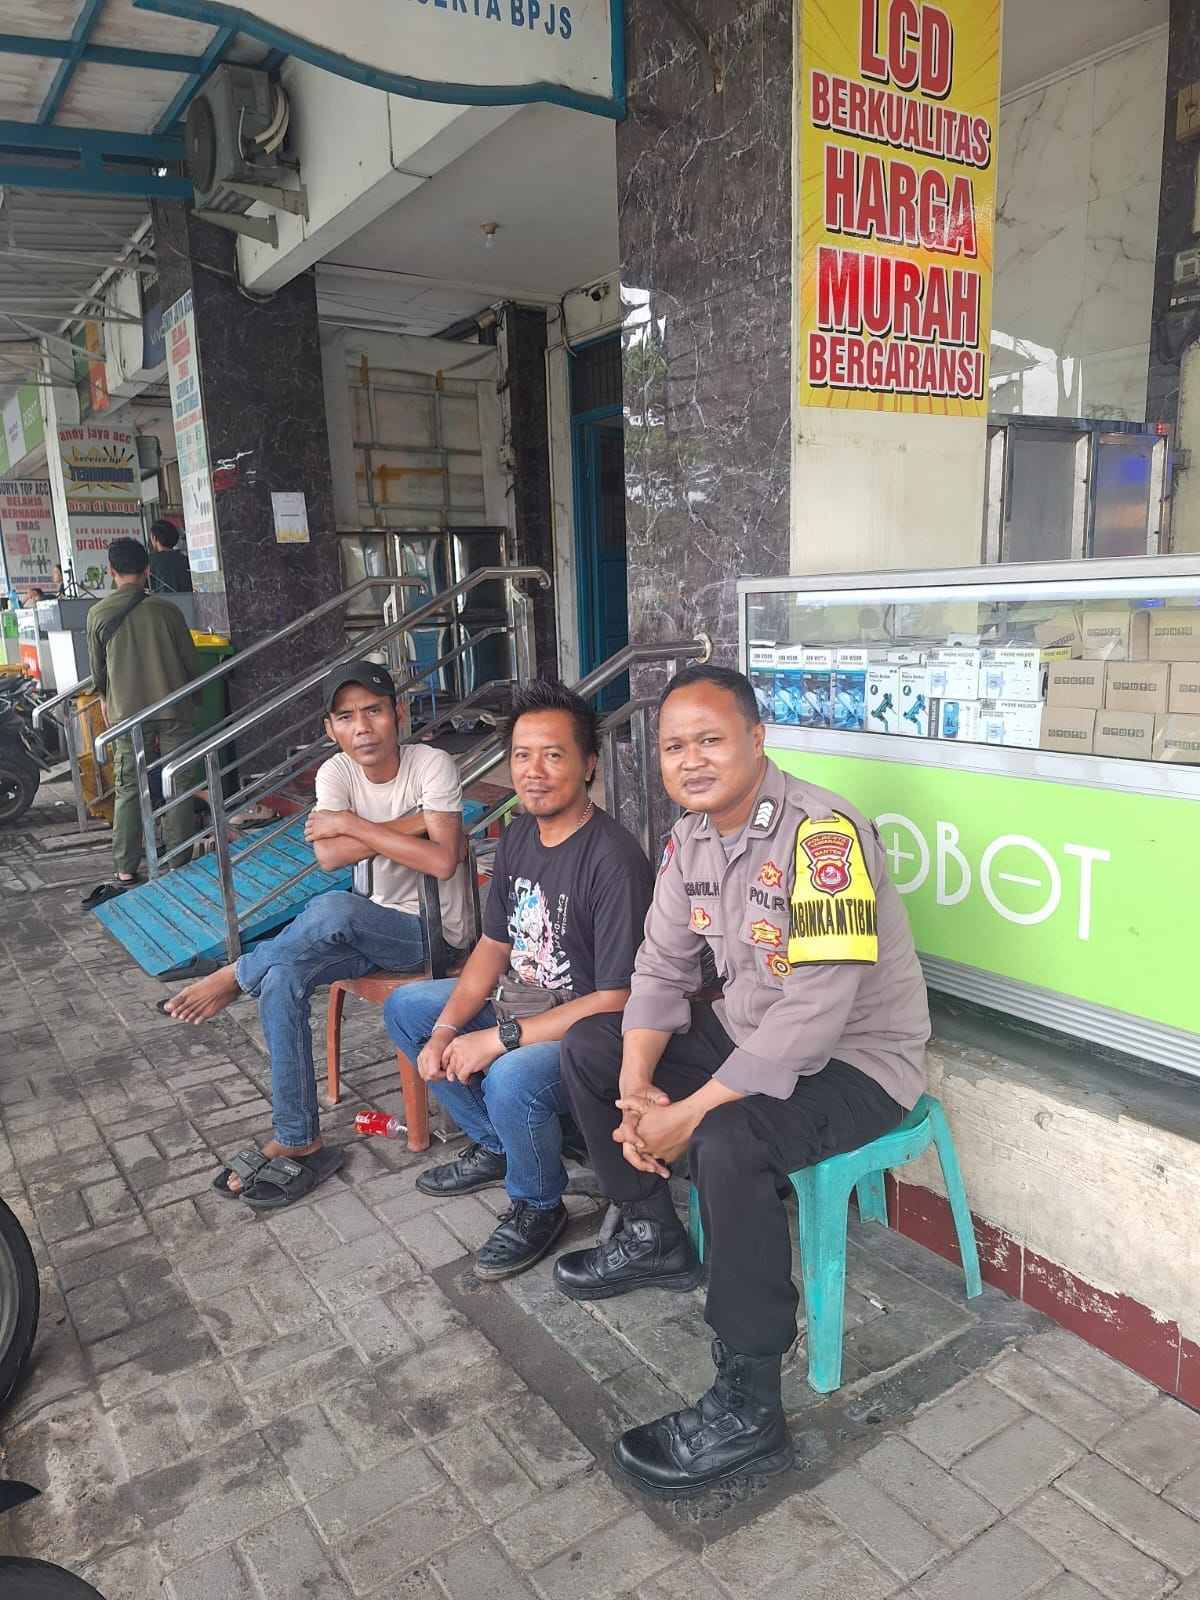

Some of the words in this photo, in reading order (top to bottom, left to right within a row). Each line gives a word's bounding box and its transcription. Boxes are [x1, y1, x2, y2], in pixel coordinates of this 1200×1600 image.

[511, 0, 573, 39] BPJS
[860, 0, 953, 100] LCD
[811, 70, 990, 169] BERKUALITAS
[823, 144, 978, 259] HARGA
[816, 247, 980, 349] MURAH
[808, 332, 984, 399] BERGARANSI
[76, 537, 109, 551] gratis
